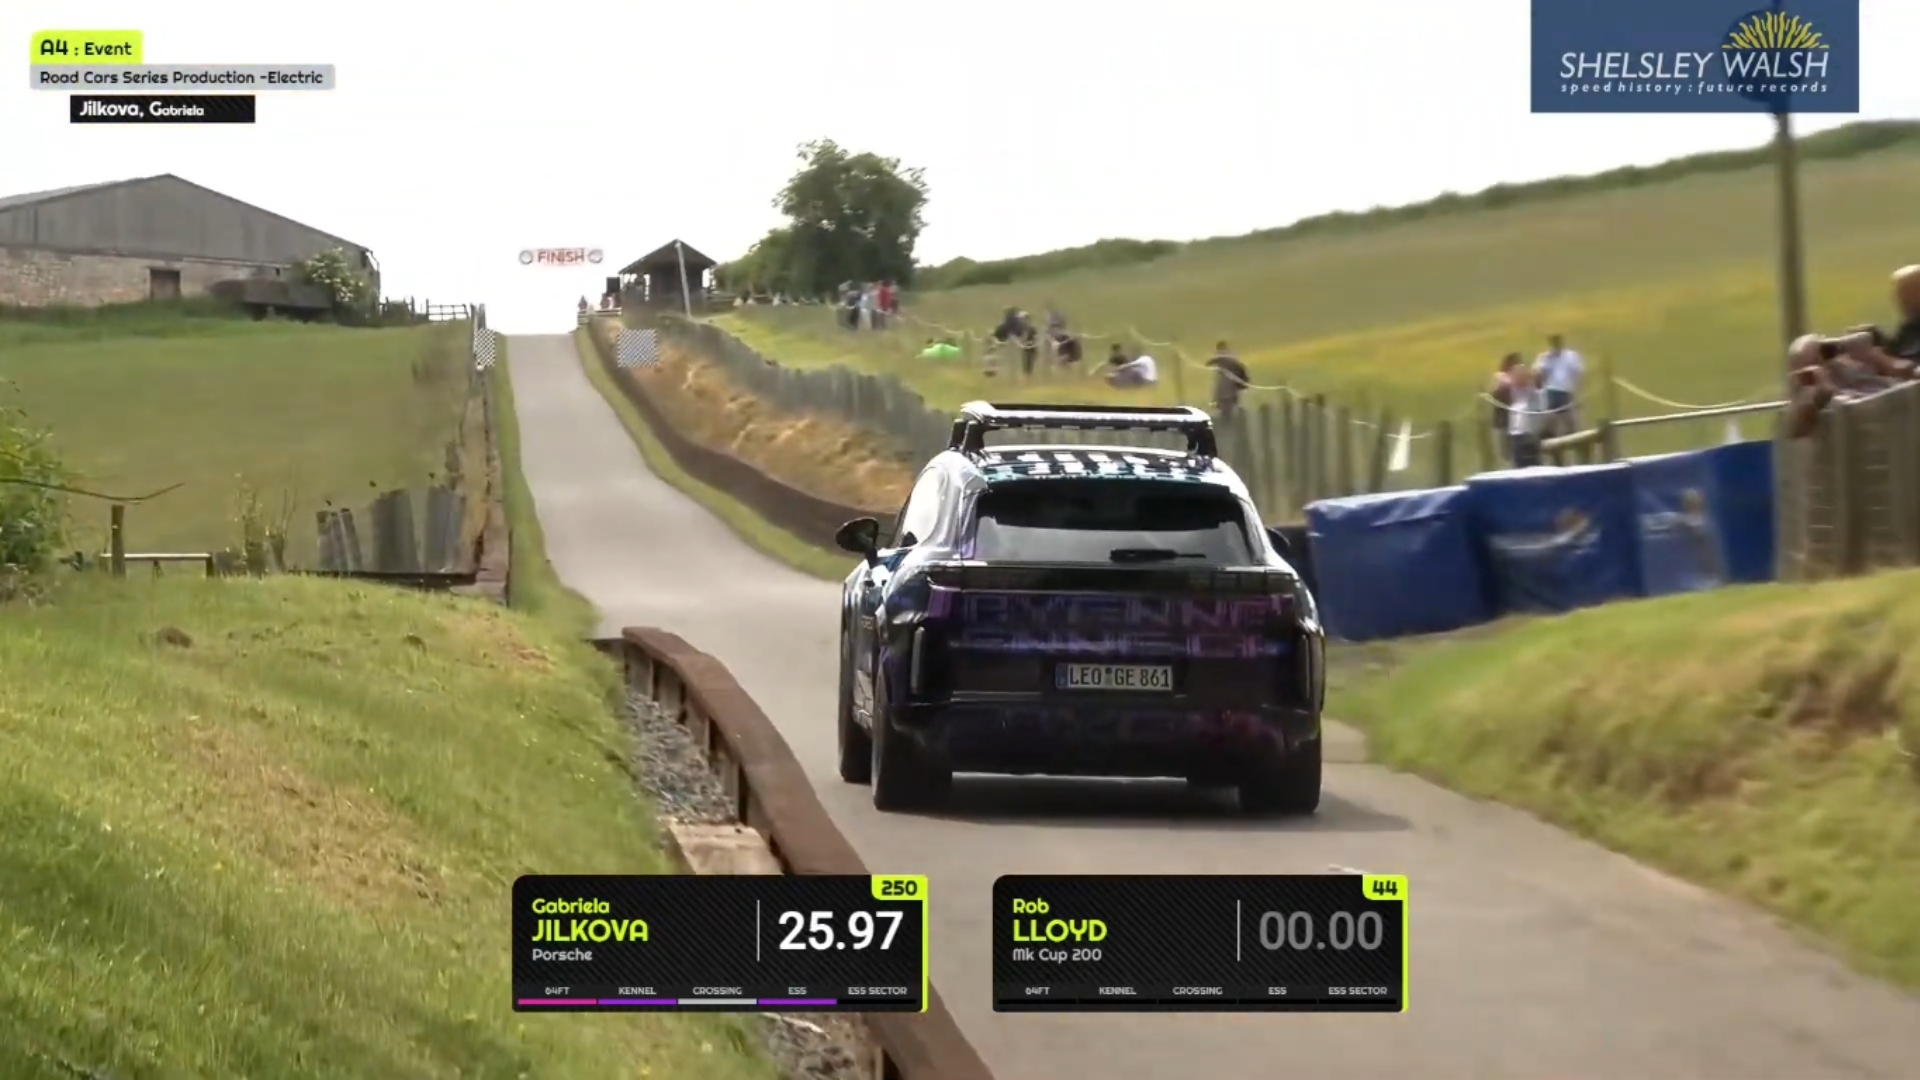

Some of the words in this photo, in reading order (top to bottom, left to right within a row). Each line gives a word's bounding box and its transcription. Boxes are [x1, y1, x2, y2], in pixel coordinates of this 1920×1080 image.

[538, 251, 584, 263] FINISH
[1069, 666, 1102, 686] LEO
[1115, 668, 1135, 686] GE
[1140, 668, 1170, 687] 861
